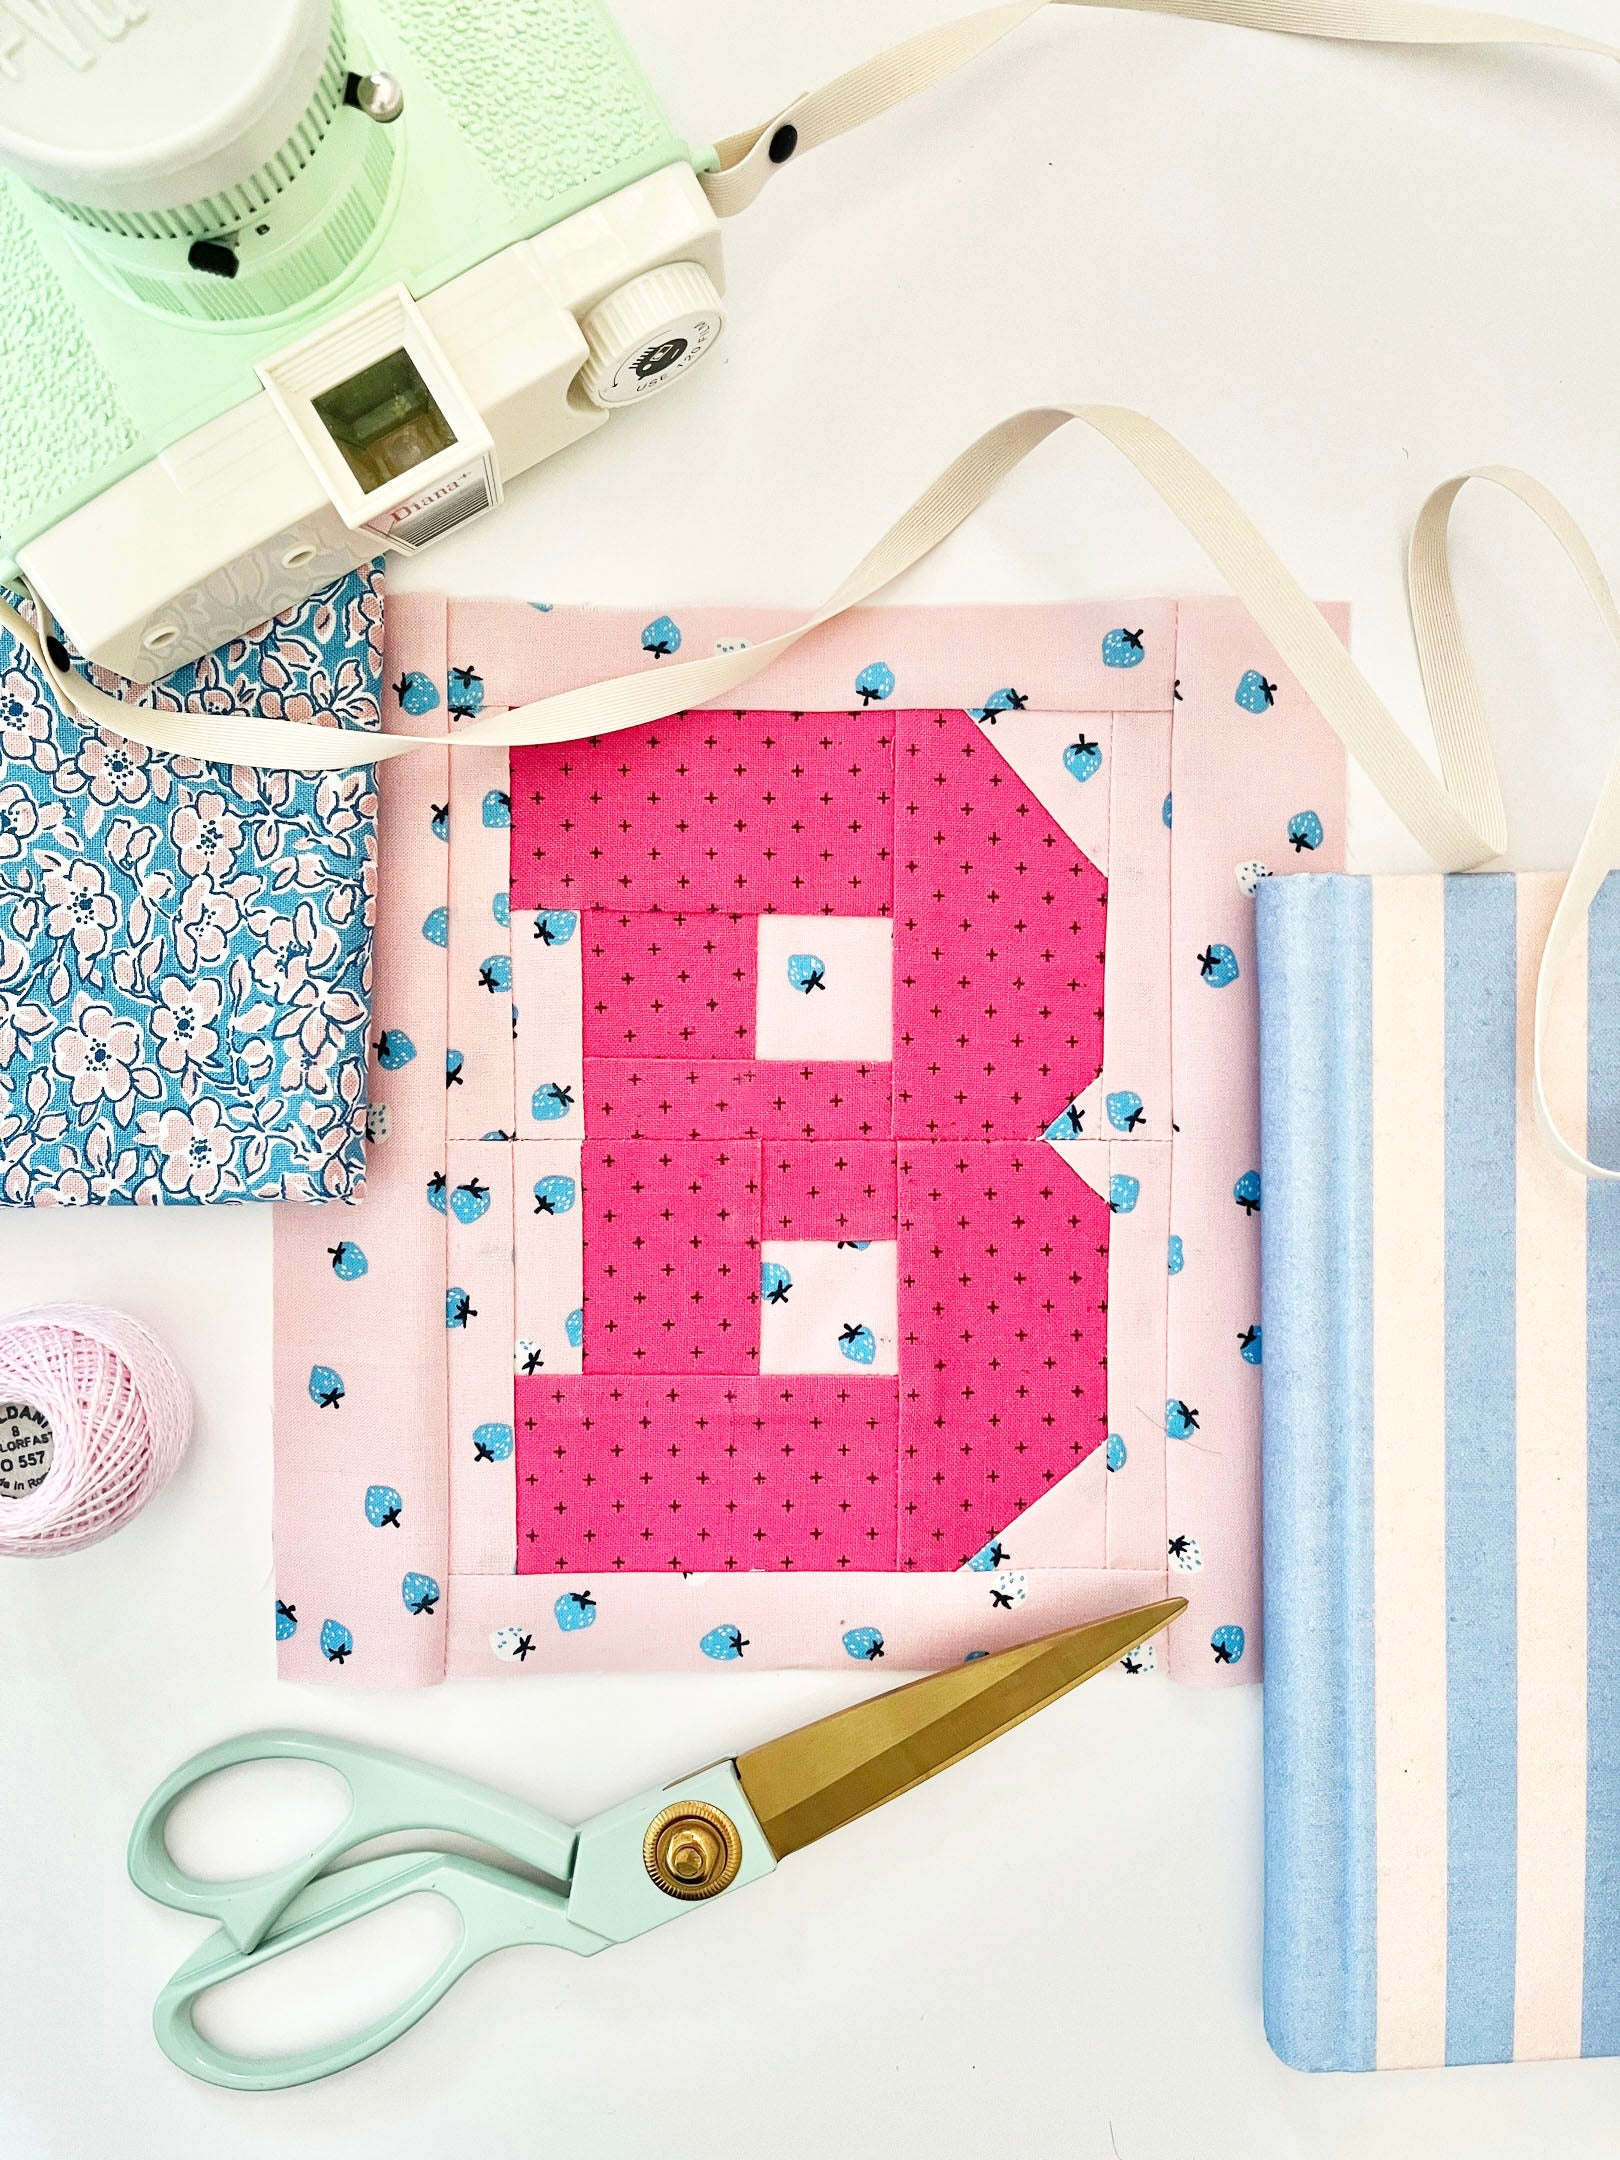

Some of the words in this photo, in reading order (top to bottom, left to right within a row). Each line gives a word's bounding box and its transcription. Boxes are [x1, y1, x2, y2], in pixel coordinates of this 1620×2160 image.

[636, 375, 669, 392] USE
[676, 346, 702, 369] 120
[693, 320, 711, 344] FILM
[11, 1425, 20, 1437] 8
[18, 1450, 45, 1468] 557
